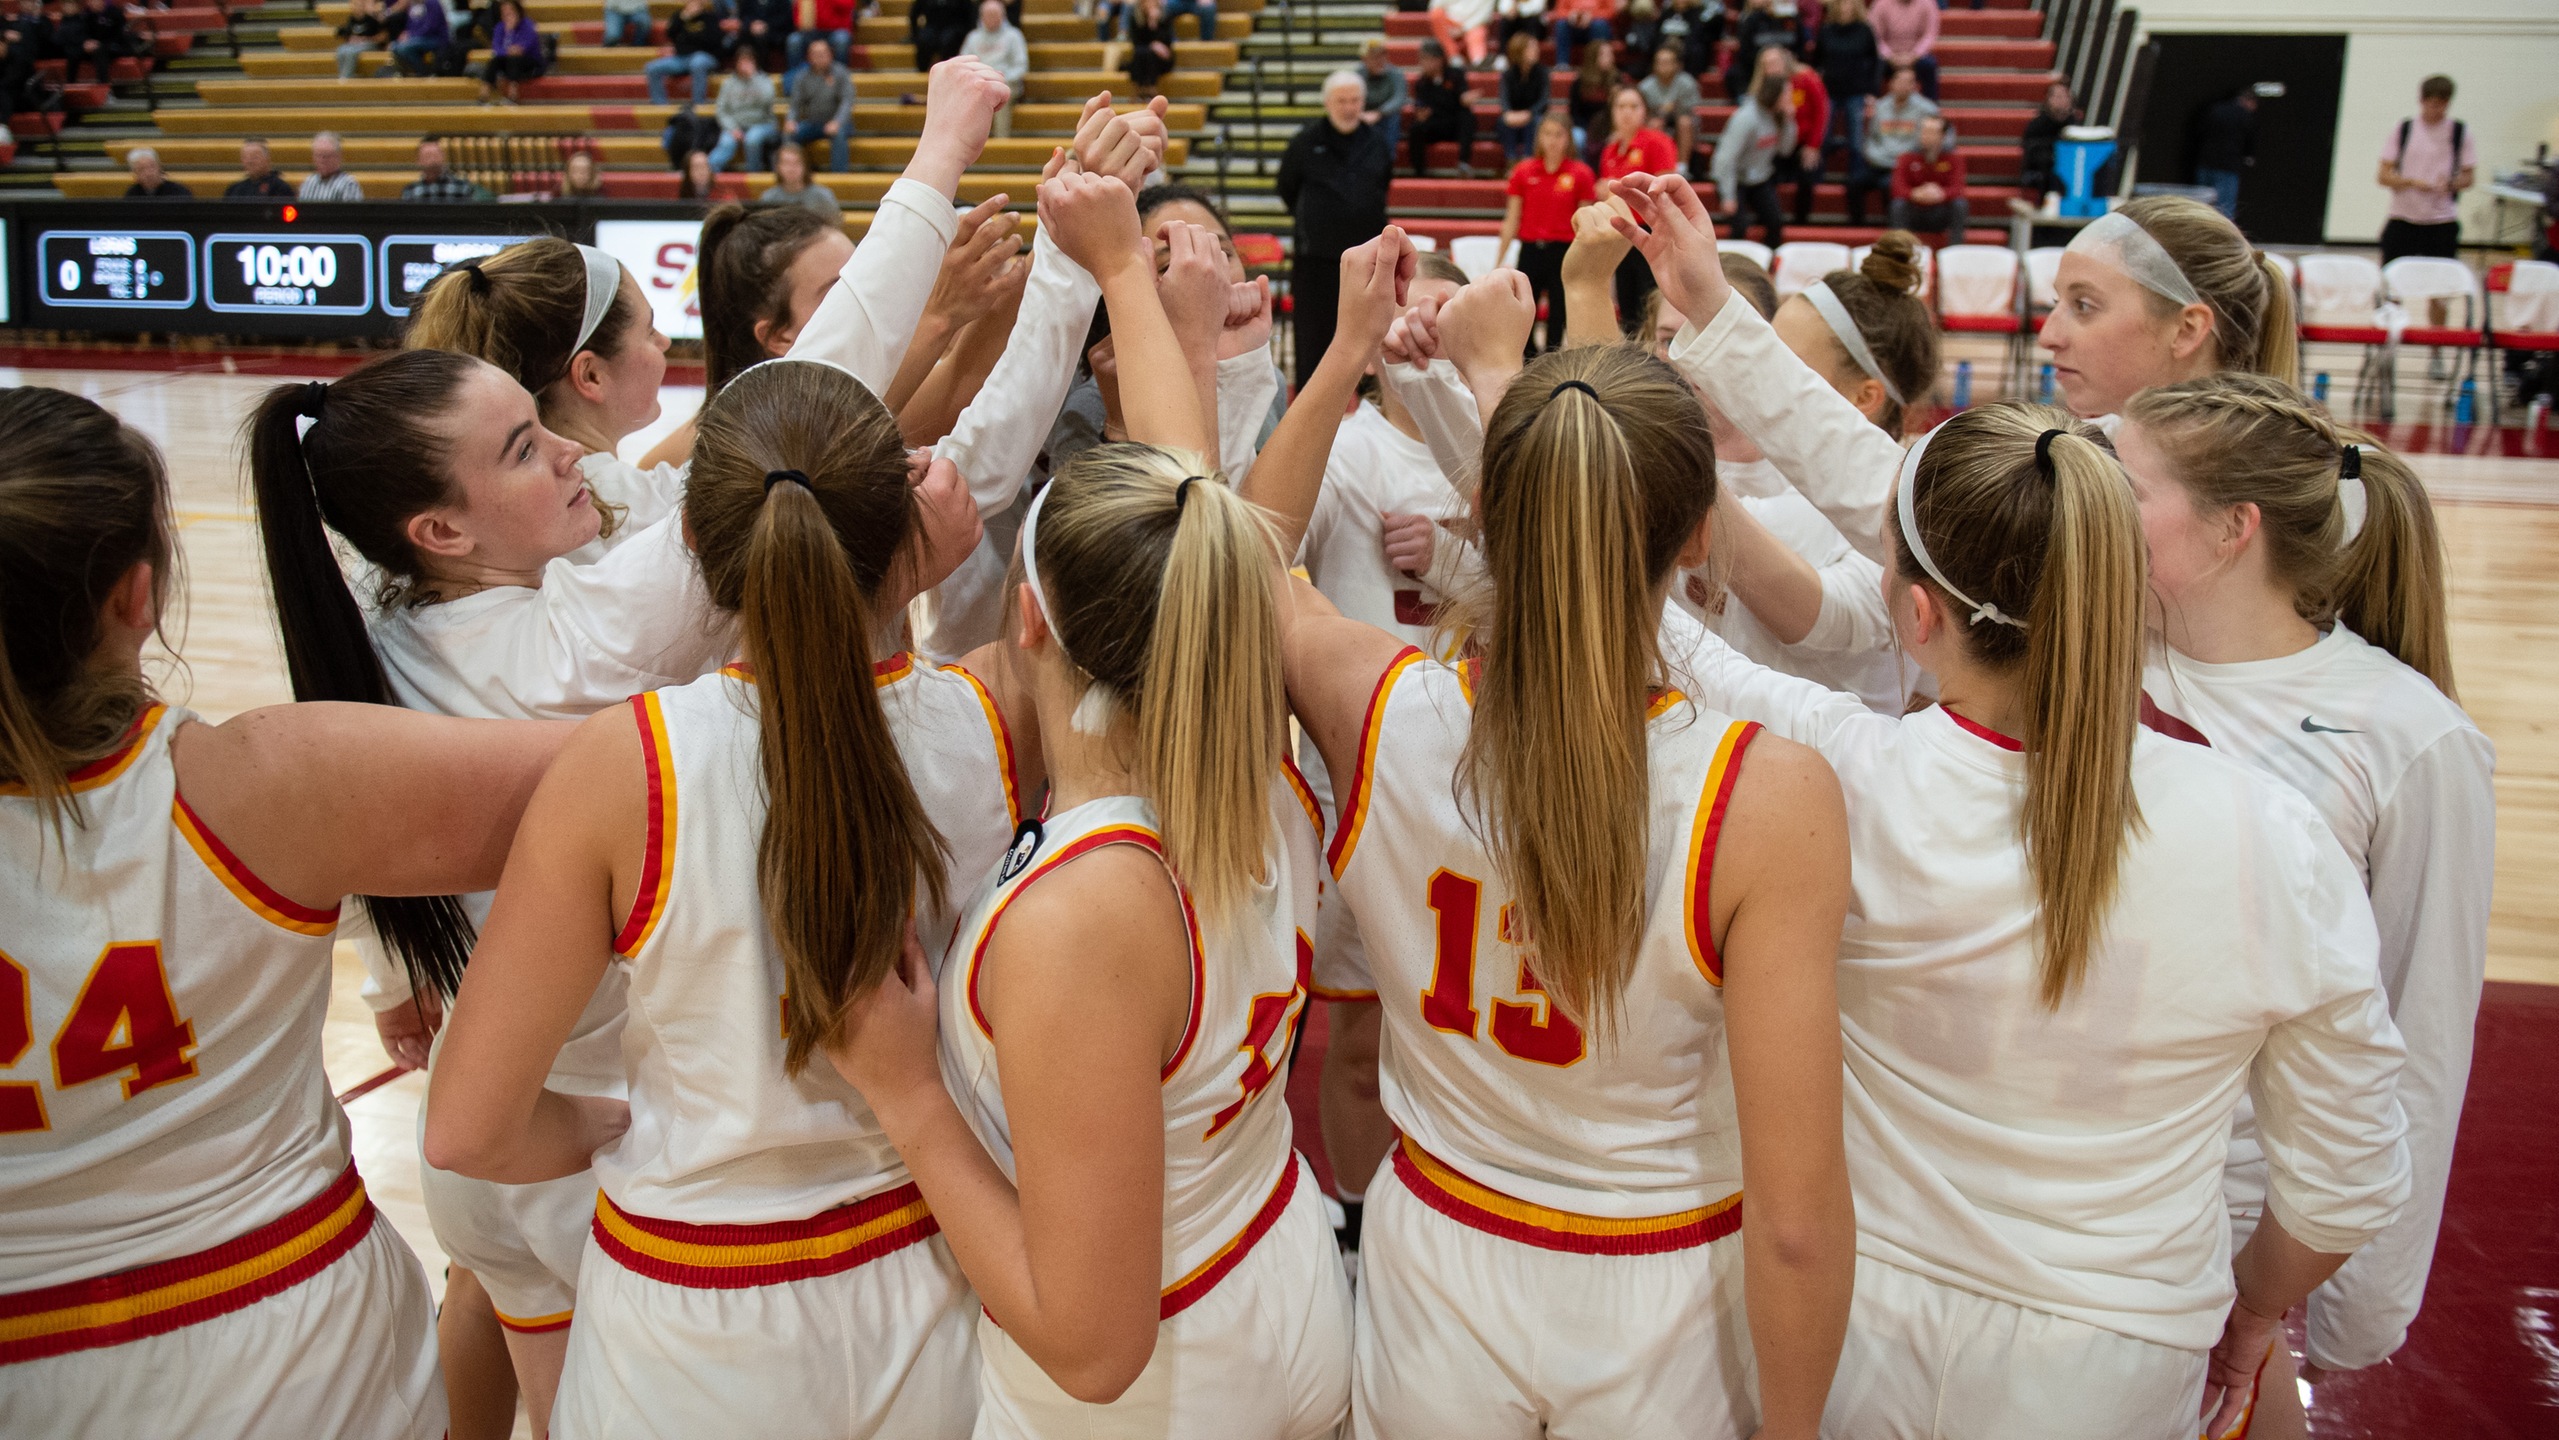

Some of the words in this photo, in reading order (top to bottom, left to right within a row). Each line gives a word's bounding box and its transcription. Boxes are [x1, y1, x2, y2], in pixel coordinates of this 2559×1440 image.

[59, 260, 81, 291] 0
[238, 245, 337, 287] 10:00
[255, 287, 303, 304] PERIOD
[306, 288, 316, 305] 1
[1203, 926, 1315, 1144] 1
